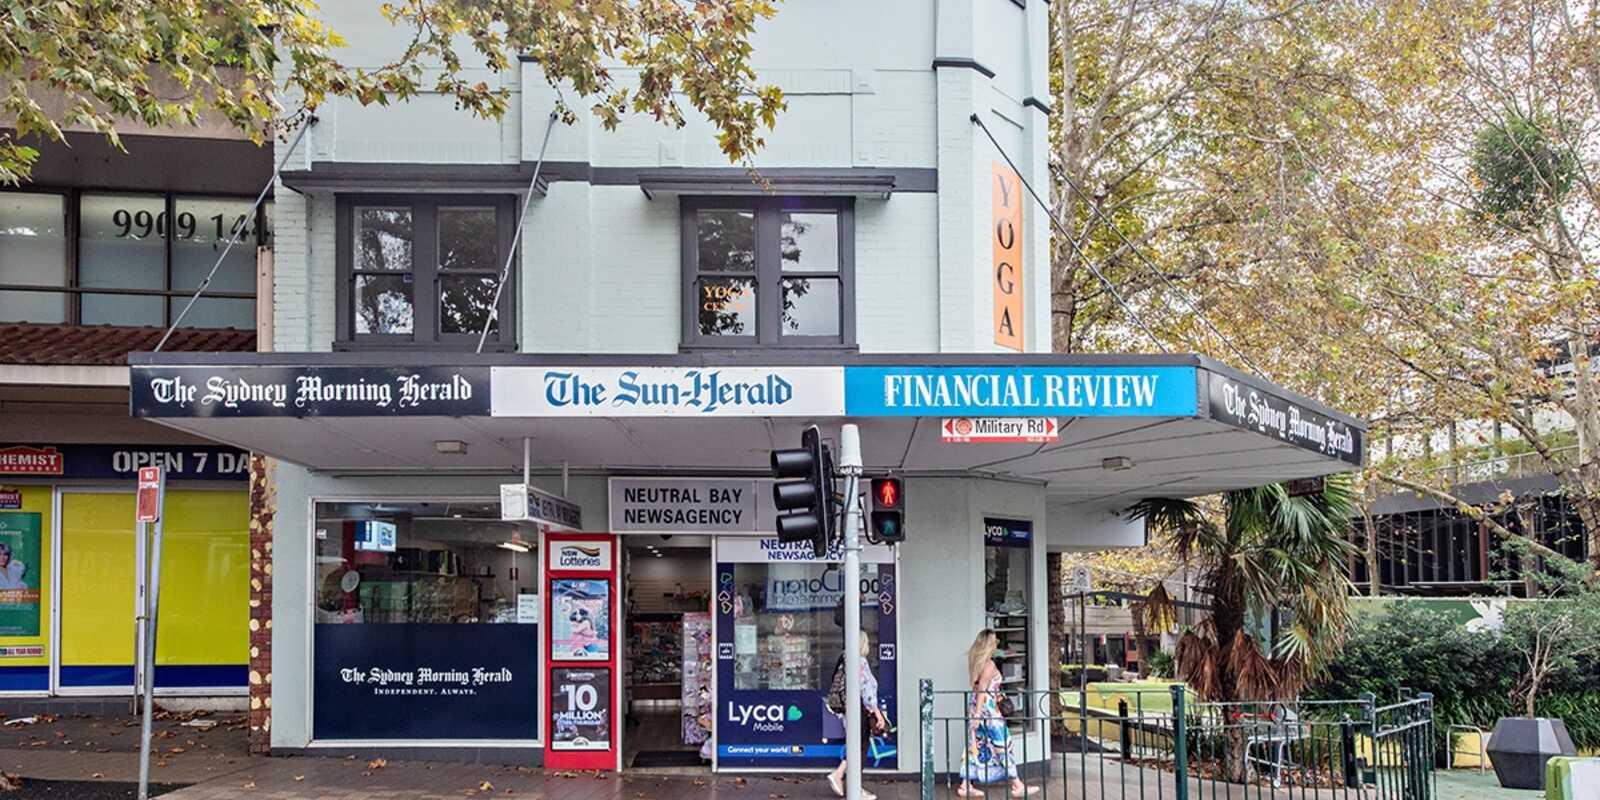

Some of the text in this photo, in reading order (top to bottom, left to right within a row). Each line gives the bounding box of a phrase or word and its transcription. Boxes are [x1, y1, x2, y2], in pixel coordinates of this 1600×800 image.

[997, 174, 1015, 337] YOGA
[151, 376, 472, 407] The Sydney Morning Herald
[544, 371, 793, 412] The Sun-Herald
[887, 375, 1040, 407] FINANCIAL
[1044, 375, 1158, 407] REVIEW
[975, 419, 1043, 436] Military Rd
[1223, 383, 1353, 455] The Sydney Morning Herald
[112, 451, 183, 472] OPEN
[193, 453, 208, 472] 7
[625, 488, 742, 503] NEUTRAL BAY
[625, 508, 742, 524] NEWSAGENCY
[760, 539, 813, 549] NEUTRA
[560, 556, 600, 567] Lotteries
[340, 667, 512, 685] The Sydney Morning Herald
[560, 711, 602, 720] MILLION
[728, 701, 784, 726] Lyca
[753, 723, 784, 732] Mobile
